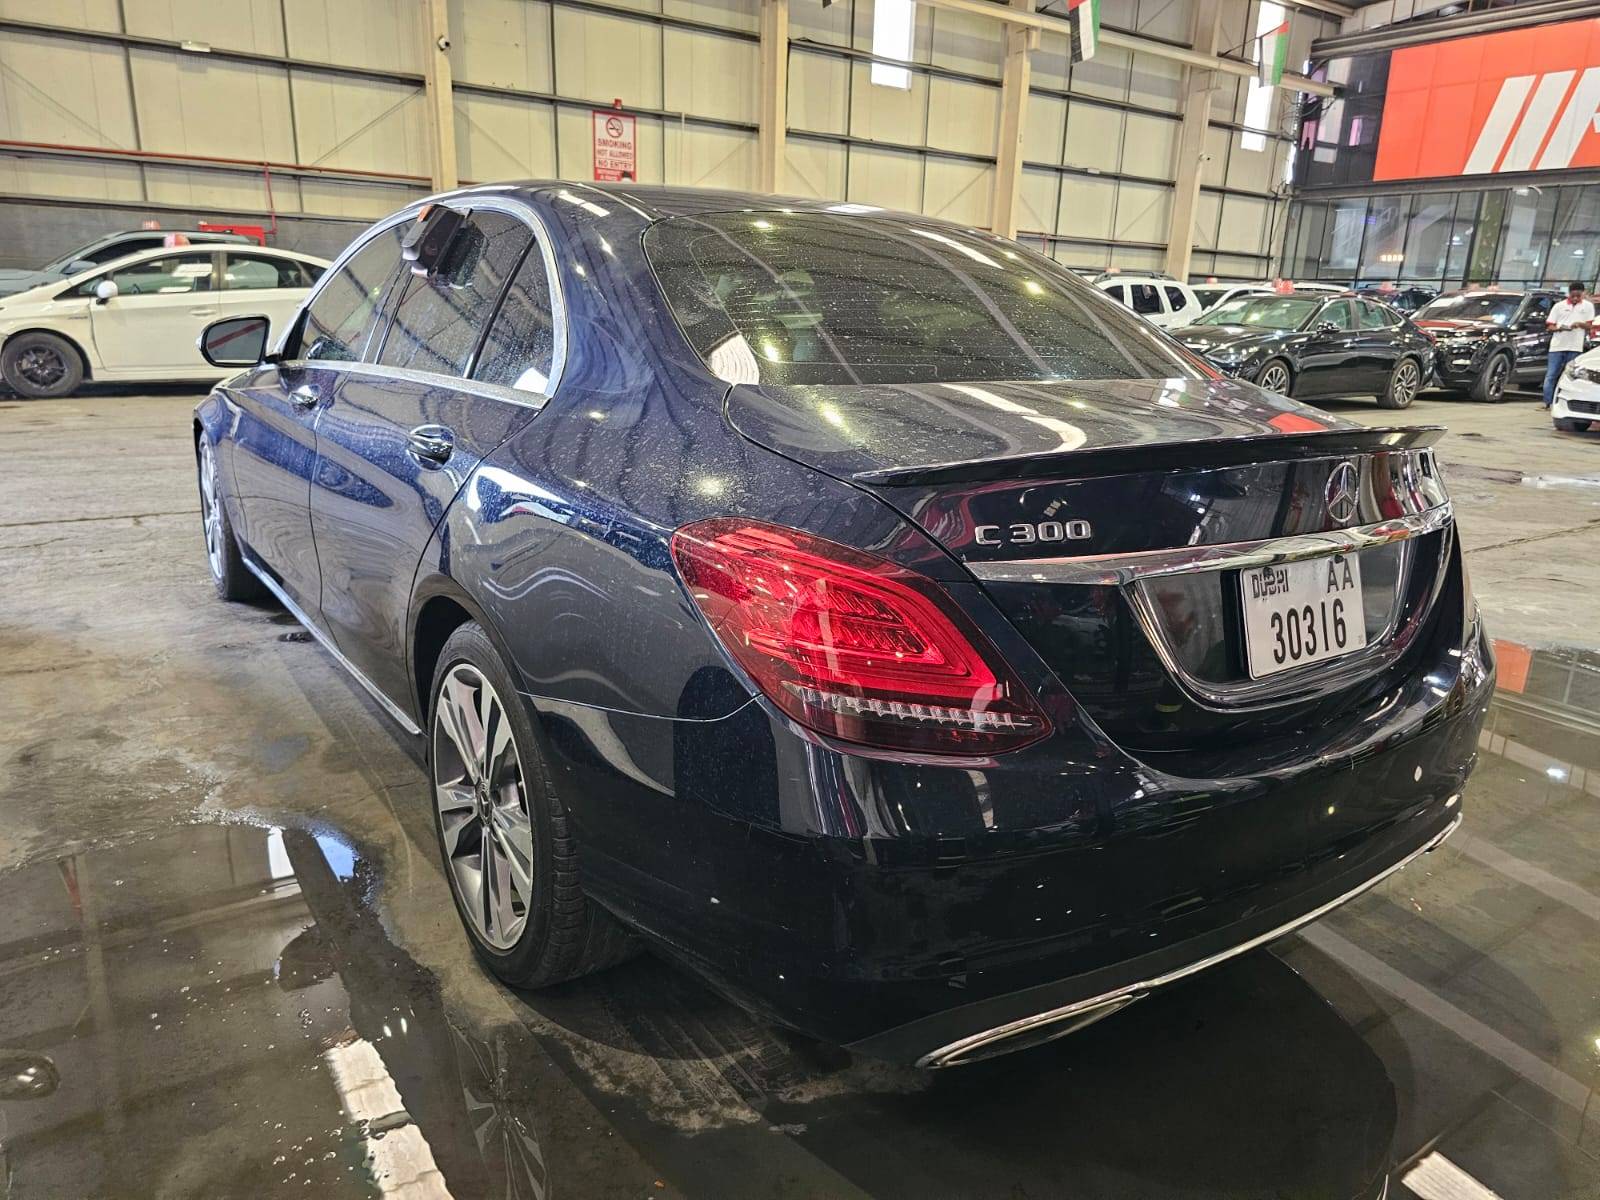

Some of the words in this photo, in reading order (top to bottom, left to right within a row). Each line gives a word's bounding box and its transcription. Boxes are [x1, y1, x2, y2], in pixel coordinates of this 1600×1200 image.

[597, 138, 633, 150] SMOKING
[597, 149, 609, 157] NOT
[609, 150, 633, 160] ALLOWED
[598, 159, 608, 168] NO
[610, 160, 632, 169] ENTRY
[975, 525, 1002, 546] C
[1009, 519, 1092, 543] 300
[1327, 558, 1355, 593] AA
[1270, 598, 1347, 664] 30316
